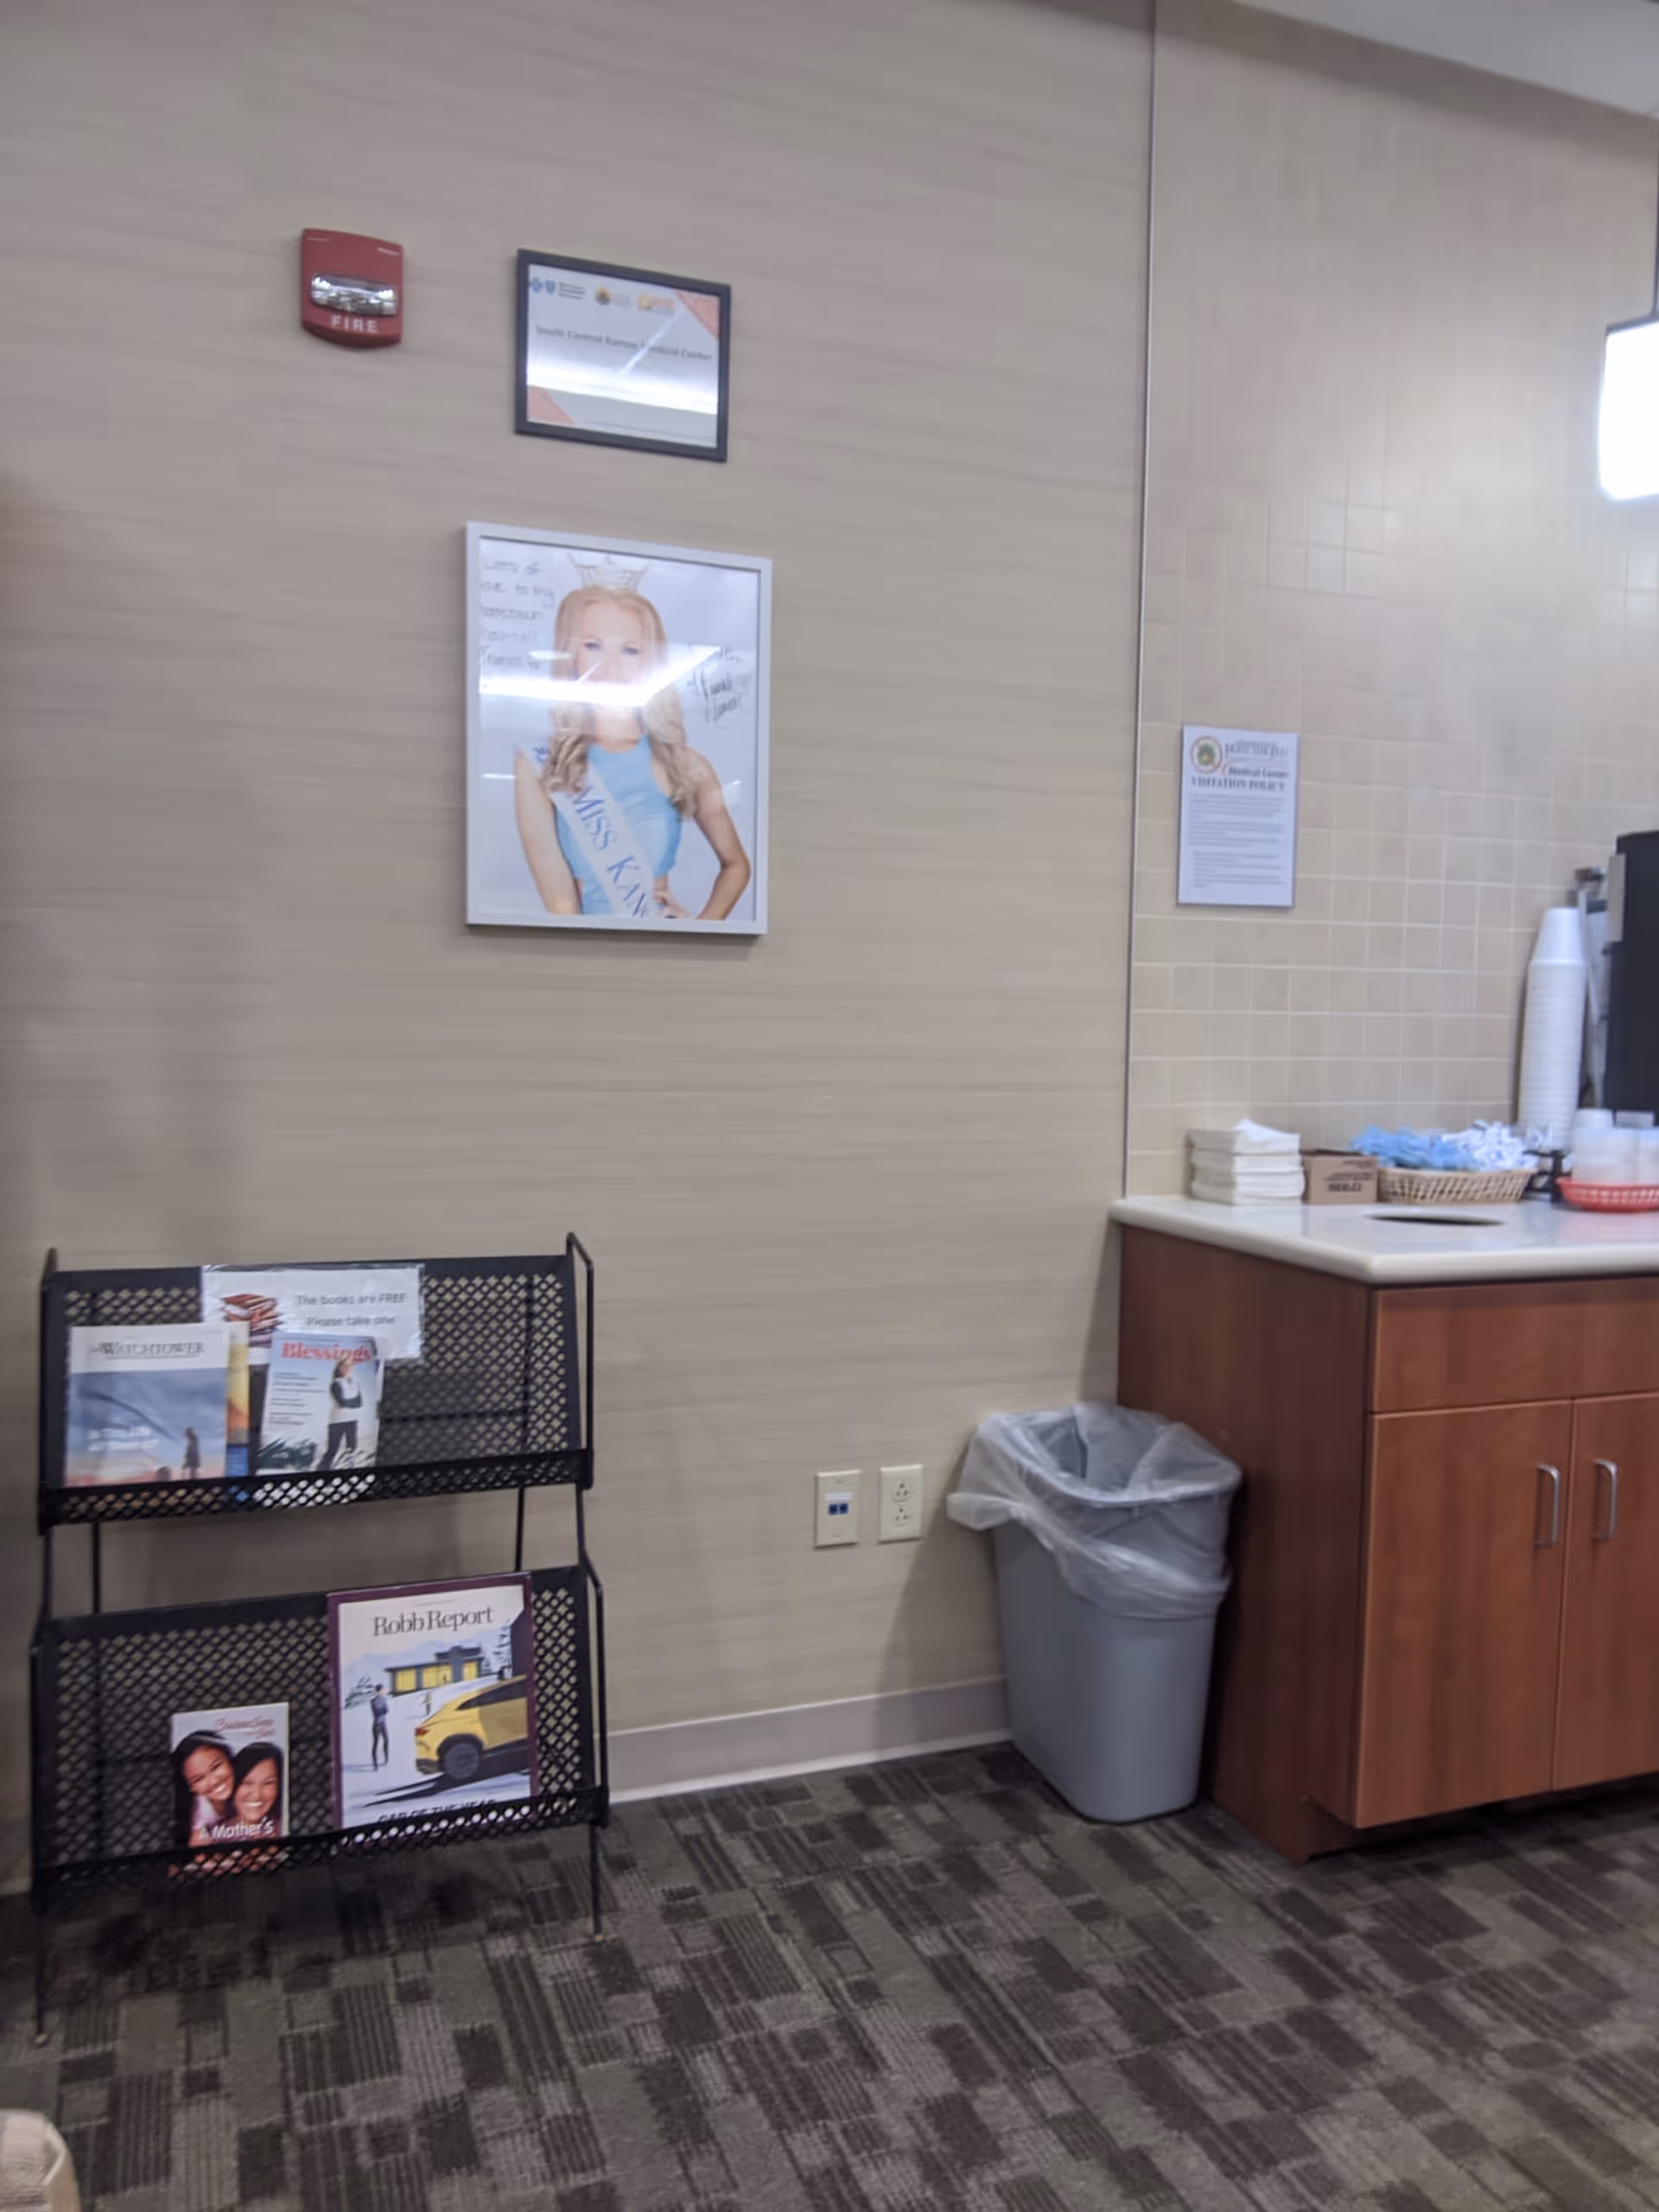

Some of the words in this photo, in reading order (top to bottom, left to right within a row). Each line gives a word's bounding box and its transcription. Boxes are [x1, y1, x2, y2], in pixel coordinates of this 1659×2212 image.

[330, 315, 378, 334] FIRE
[567, 330, 603, 344] Central
[680, 346, 713, 361] Center
[1191, 775, 1247, 789] VISITATION
[1249, 779, 1286, 791] POLICY
[572, 783, 617, 851] MISS
[296, 1294, 317, 1306] The
[320, 1294, 355, 1305] books
[357, 1294, 377, 1305] are
[378, 1293, 407, 1304] FREE
[306, 1315, 344, 1326] Please
[346, 1315, 371, 1325] take
[374, 1316, 396, 1325] one
[281, 1341, 372, 1363] Blessings
[373, 1611, 425, 1637] Robb
[427, 1605, 493, 1632] Report
[212, 1815, 275, 1839] Mother's
